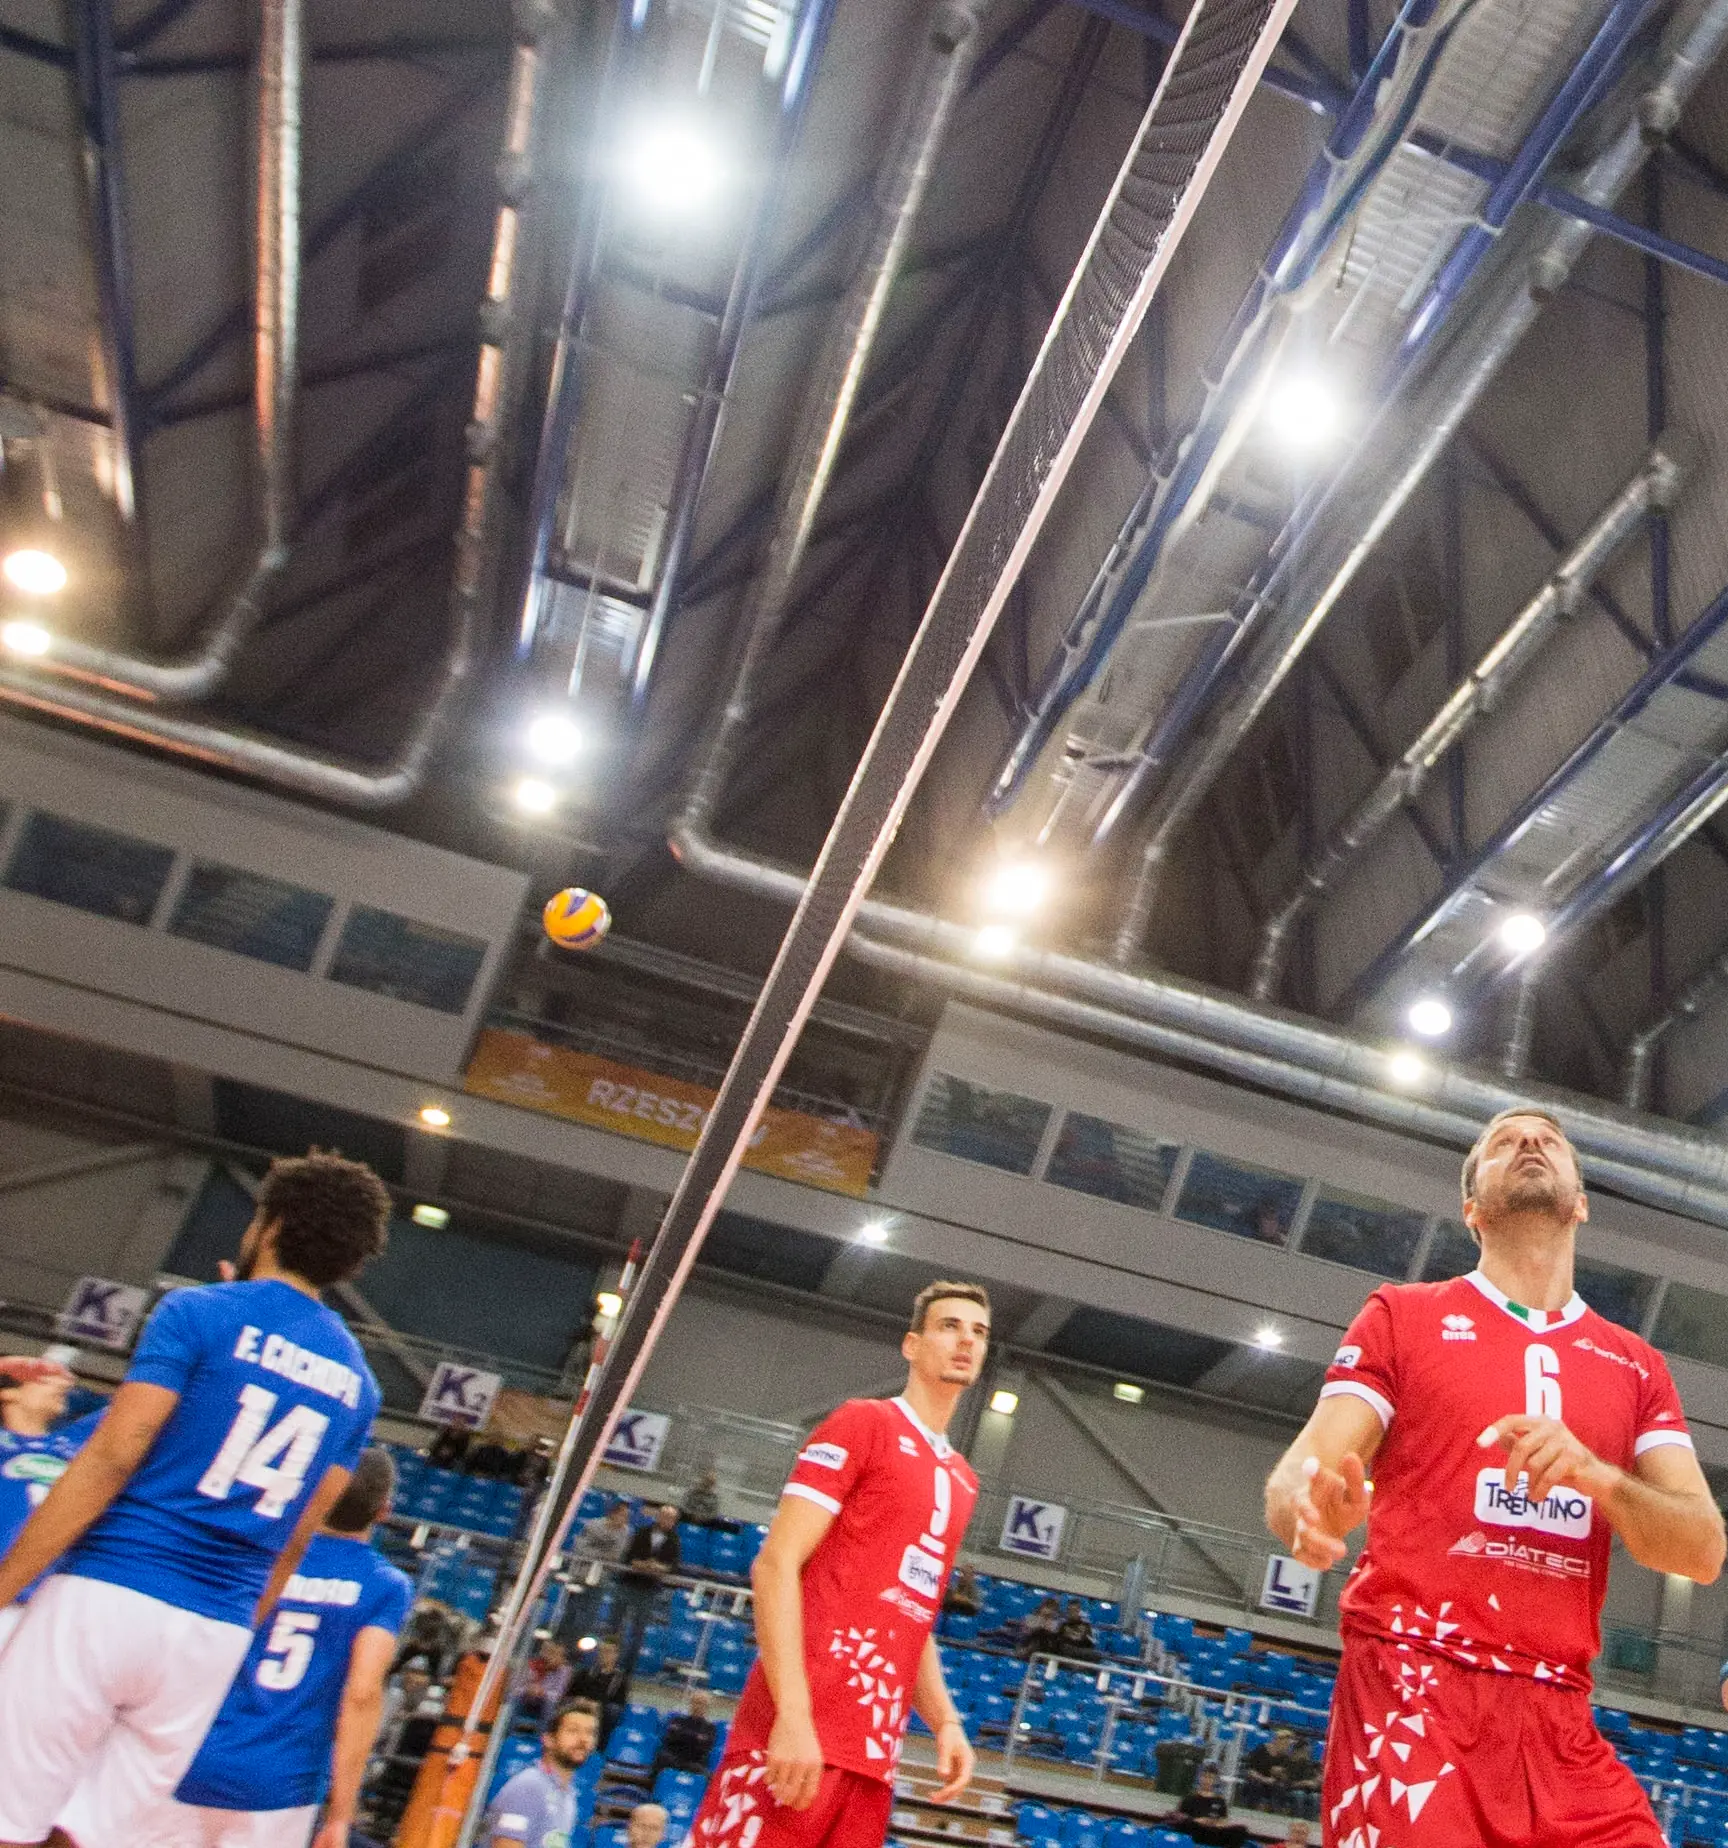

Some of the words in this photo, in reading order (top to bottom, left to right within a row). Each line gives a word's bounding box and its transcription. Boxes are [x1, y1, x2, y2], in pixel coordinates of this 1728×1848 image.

[436, 1368, 488, 1412] K2
[1523, 1343, 1563, 1421] 6
[197, 1383, 331, 1519] 14
[1010, 1501, 1054, 1543] K1
[256, 1609, 321, 1692] 5
